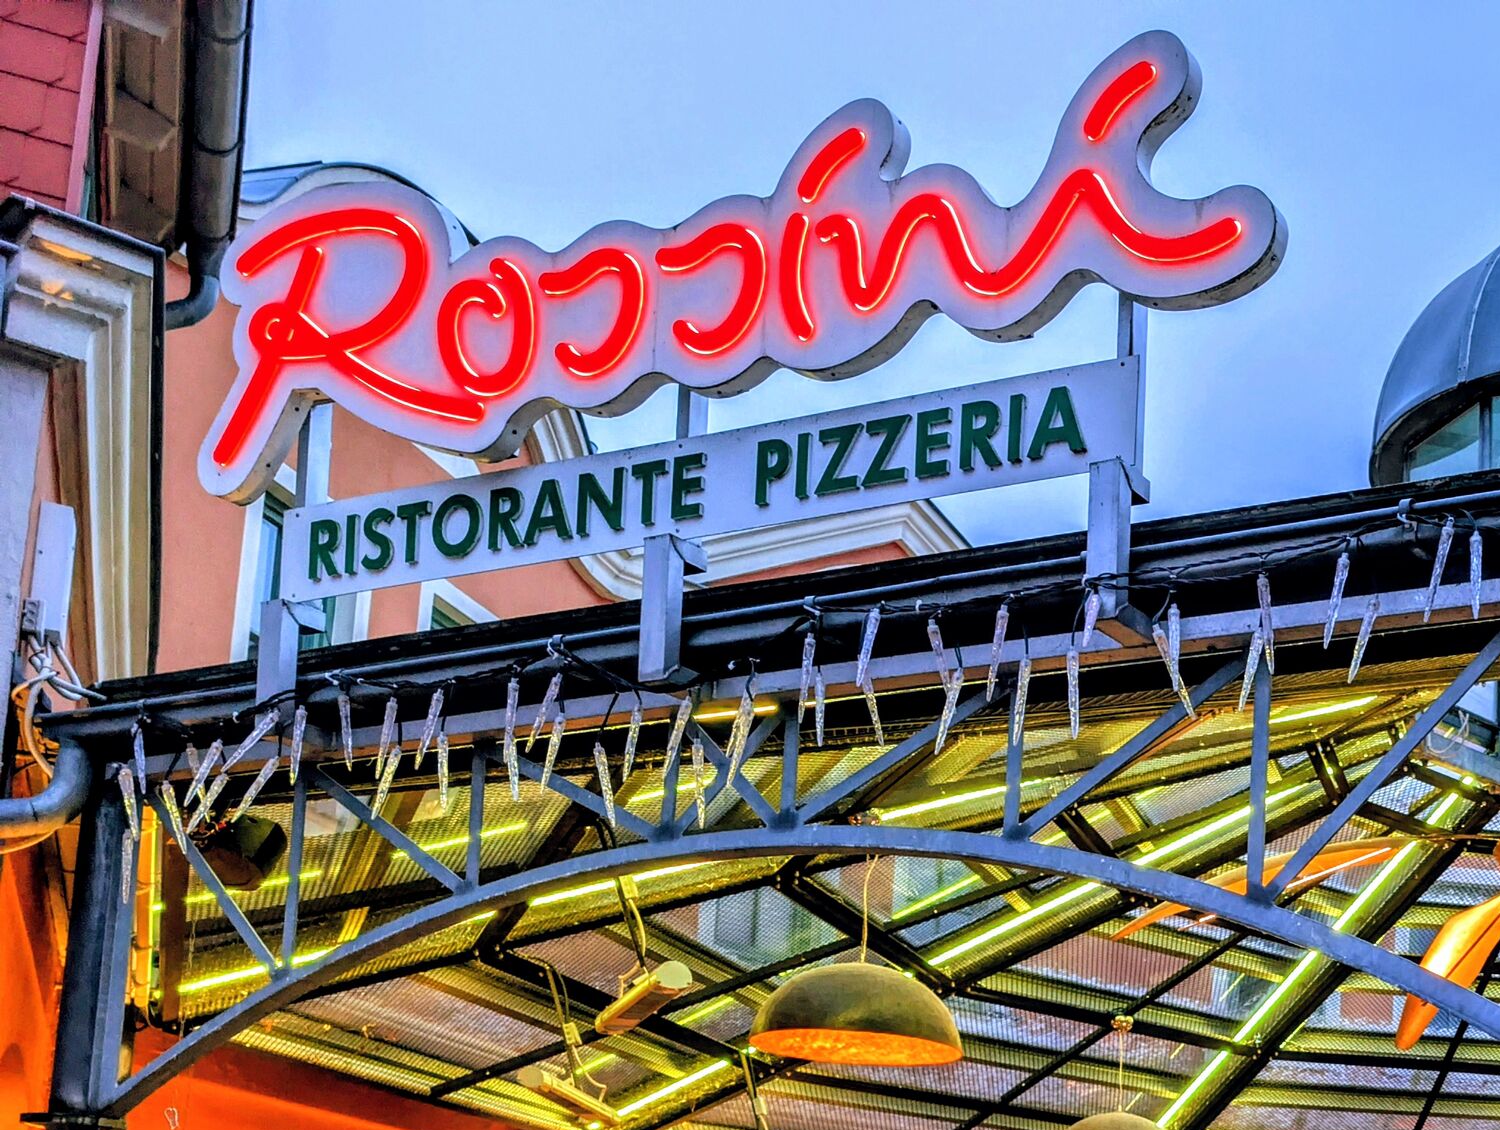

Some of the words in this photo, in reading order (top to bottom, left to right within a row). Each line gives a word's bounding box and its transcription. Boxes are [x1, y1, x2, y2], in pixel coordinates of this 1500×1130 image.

[211, 60, 1245, 467] Rossini
[308, 453, 706, 582] RISTORANTE
[754, 386, 1087, 508] PIZZERIA
